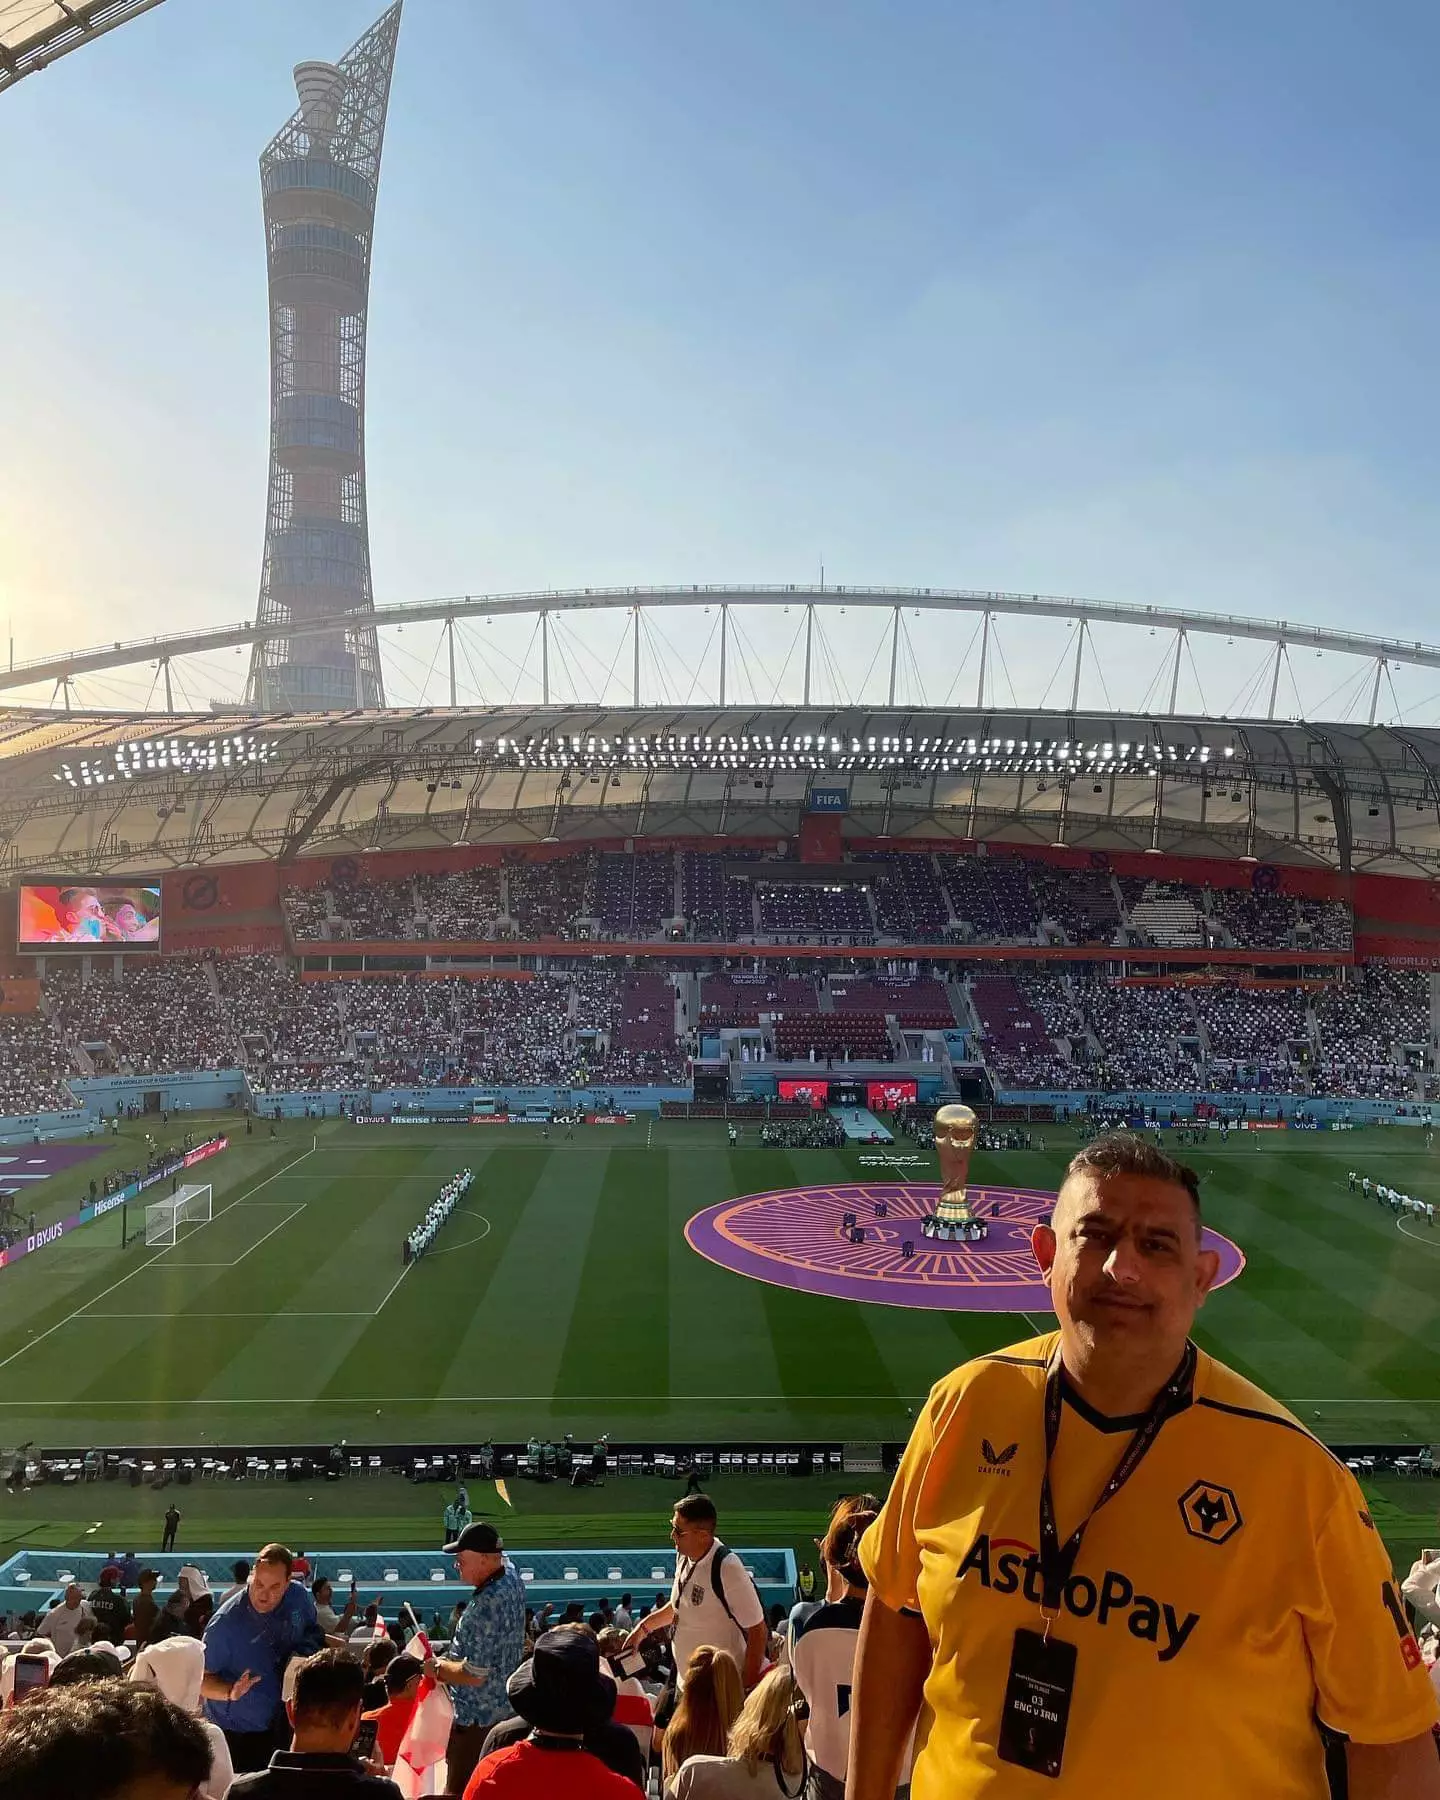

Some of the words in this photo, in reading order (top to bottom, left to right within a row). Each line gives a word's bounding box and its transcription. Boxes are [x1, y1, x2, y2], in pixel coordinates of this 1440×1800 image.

[816, 795, 841, 805] FIFA
[1388, 956, 1429, 966] WORLD
[391, 1116, 430, 1124] Hisense
[94, 1192, 125, 1217] Hisense
[37, 1221, 63, 1248] BYJU'S
[956, 1535, 1200, 1662] AstoPay
[1031, 1695, 1044, 1706] 03
[1014, 1700, 1032, 1714] ENG
[1040, 1710, 1058, 1723] IRN
